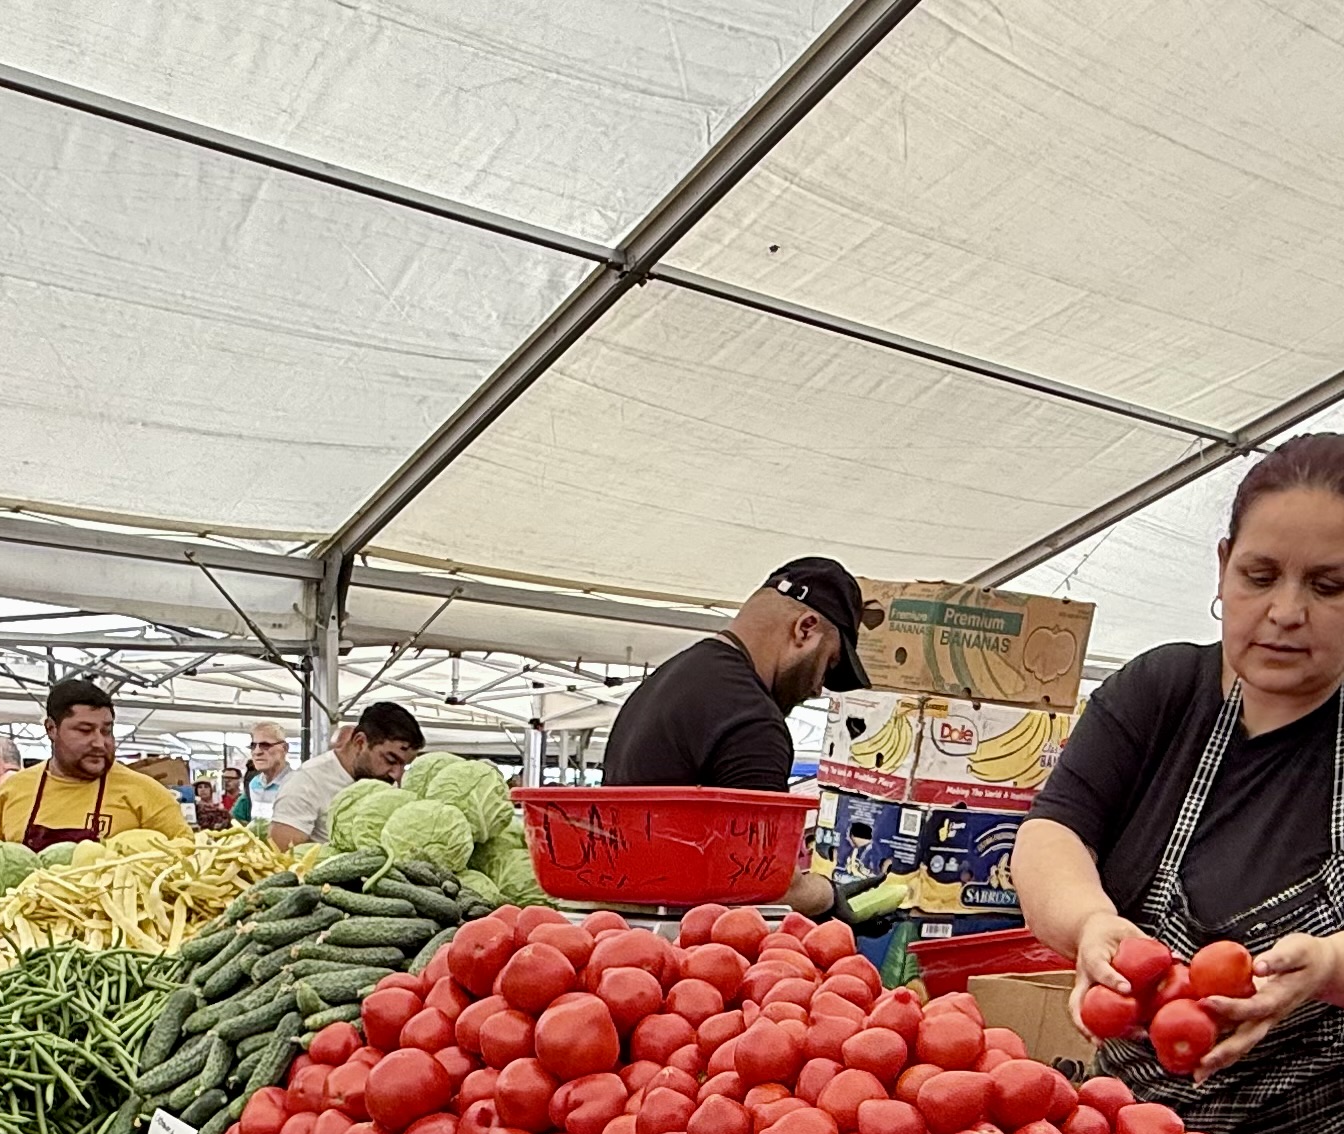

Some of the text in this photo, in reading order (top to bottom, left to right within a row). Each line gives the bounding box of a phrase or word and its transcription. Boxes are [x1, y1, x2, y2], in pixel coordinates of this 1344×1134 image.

[944, 607, 1005, 631] Premium
[939, 629, 1012, 654] BANANAS
[940, 722, 974, 741] Dole
